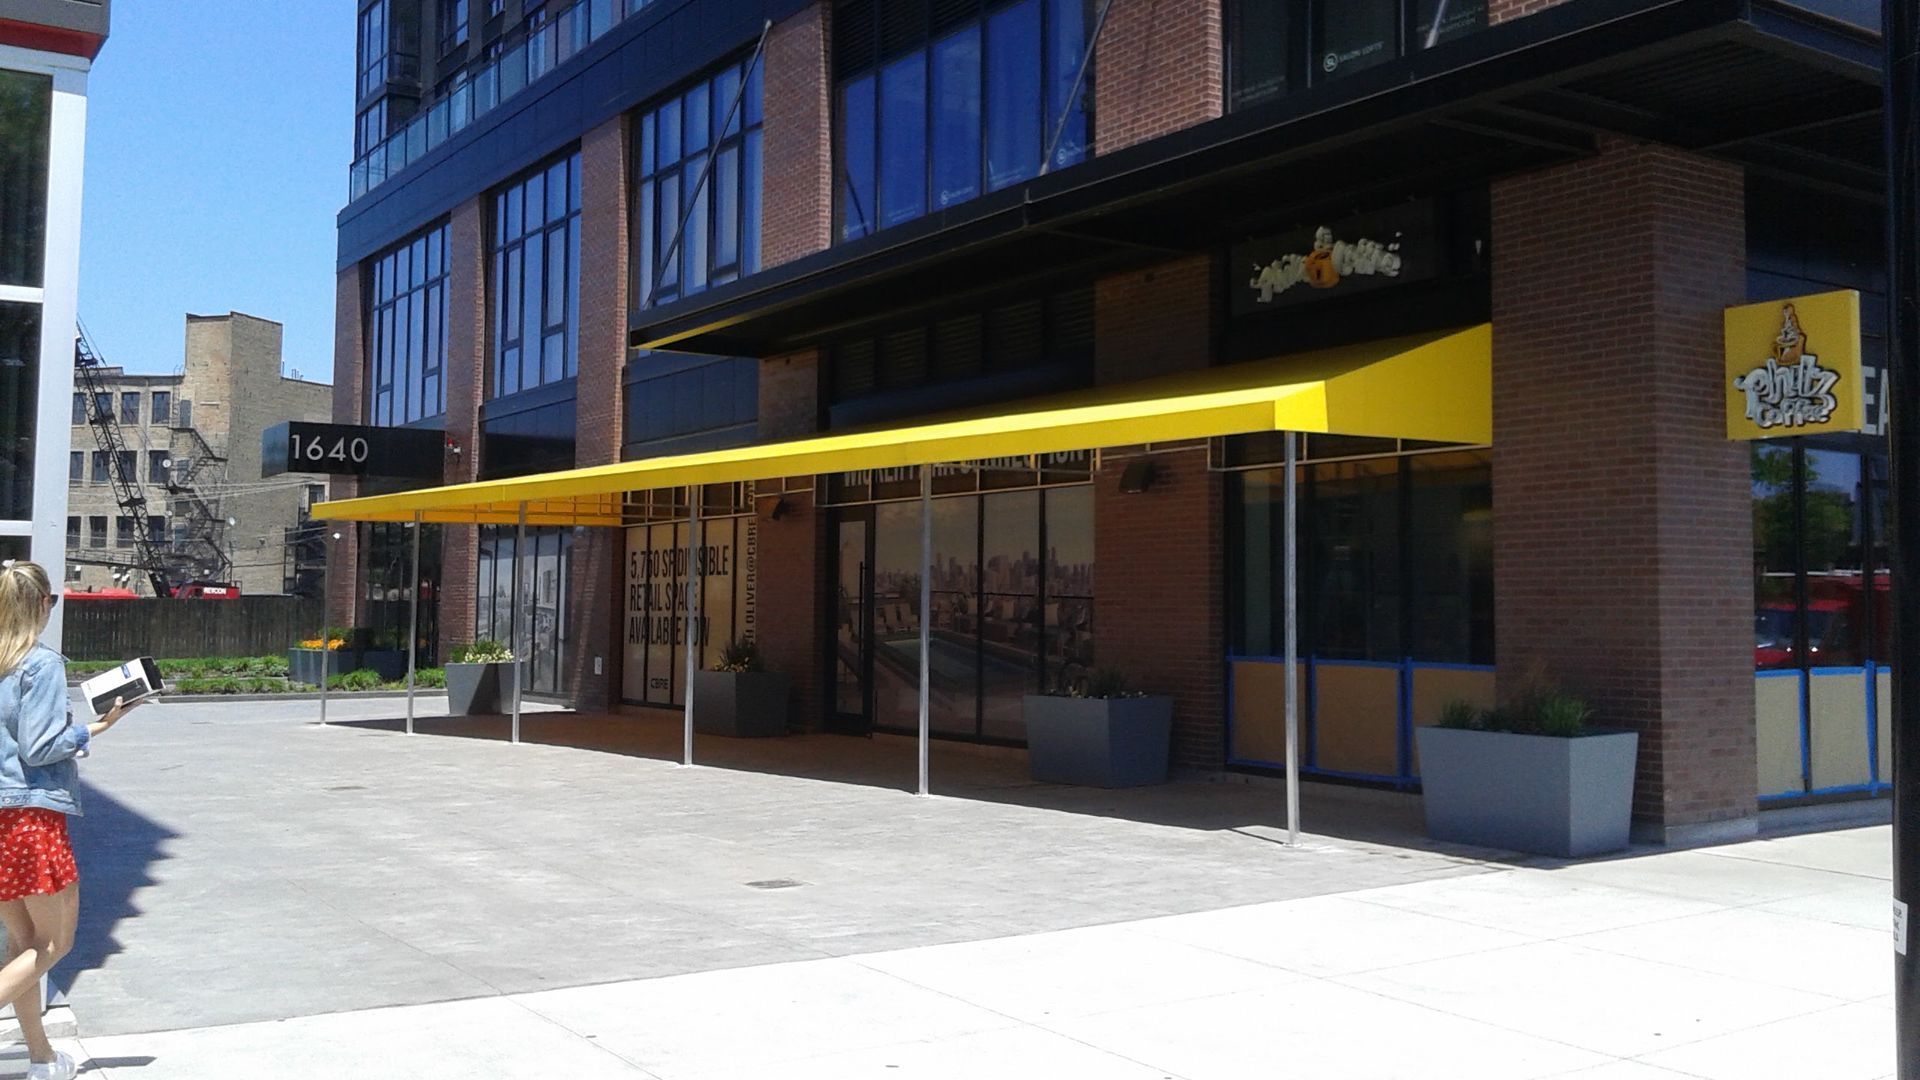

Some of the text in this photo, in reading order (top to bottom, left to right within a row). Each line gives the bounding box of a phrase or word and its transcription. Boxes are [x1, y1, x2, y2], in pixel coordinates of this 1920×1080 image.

[291, 434, 368, 462] 1640
[631, 550, 660, 581] 5,750
[677, 545, 729, 576] DIISIBLE
[630, 583, 663, 611] RETAIL
[629, 616, 682, 645] AVALABLE
[650, 678, 669, 690] CBRE
